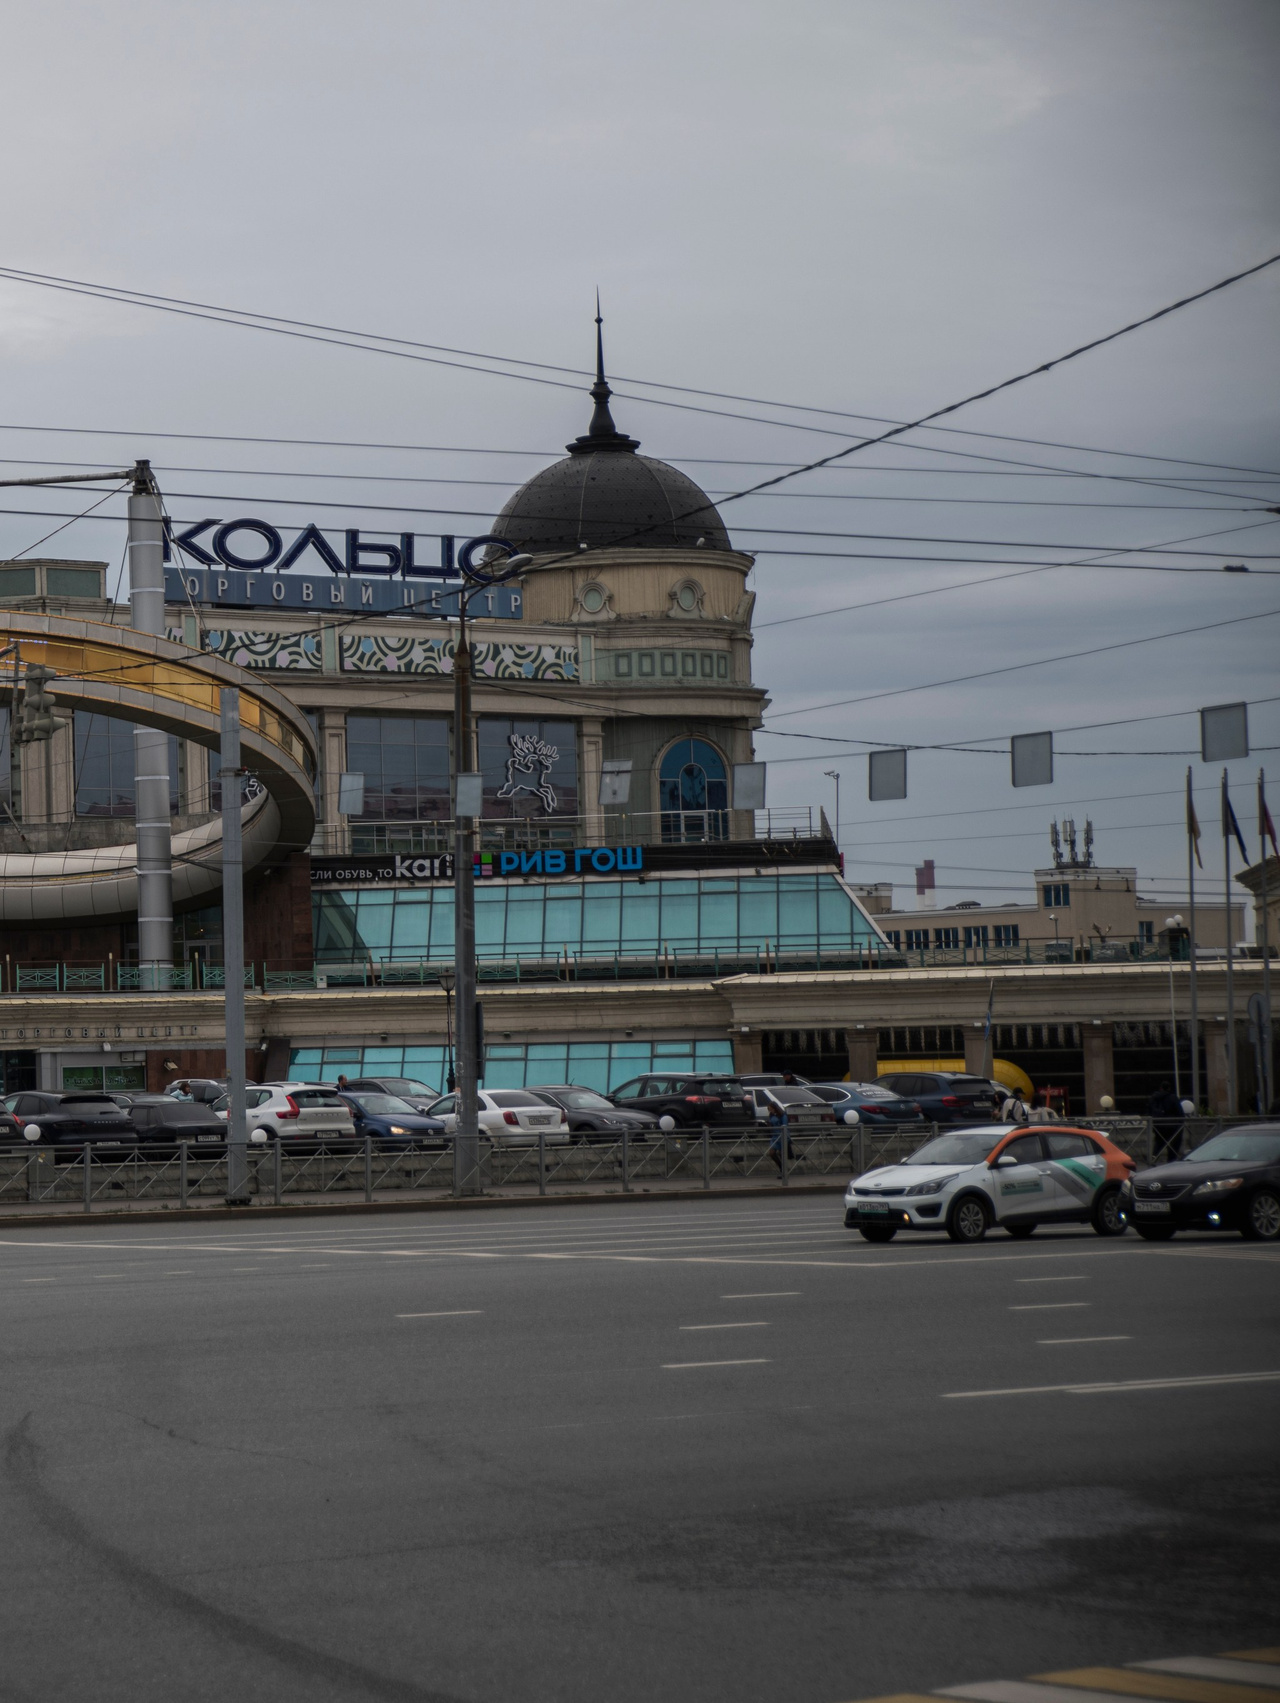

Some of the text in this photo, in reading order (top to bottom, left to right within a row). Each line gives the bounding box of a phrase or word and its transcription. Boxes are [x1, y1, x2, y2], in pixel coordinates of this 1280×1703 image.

[162, 516, 520, 584] КОЛЬЦО
[163, 575, 373, 606] ОРГОВЫЙ
[395, 853, 455, 878] kari
[500, 845, 643, 875] РИВ ГОШ
[309, 869, 332, 880] СЛИ
[377, 868, 394, 879] ТО
[1, 1023, 198, 1039] ТОРГОВЫЙ ЦЕНТР
